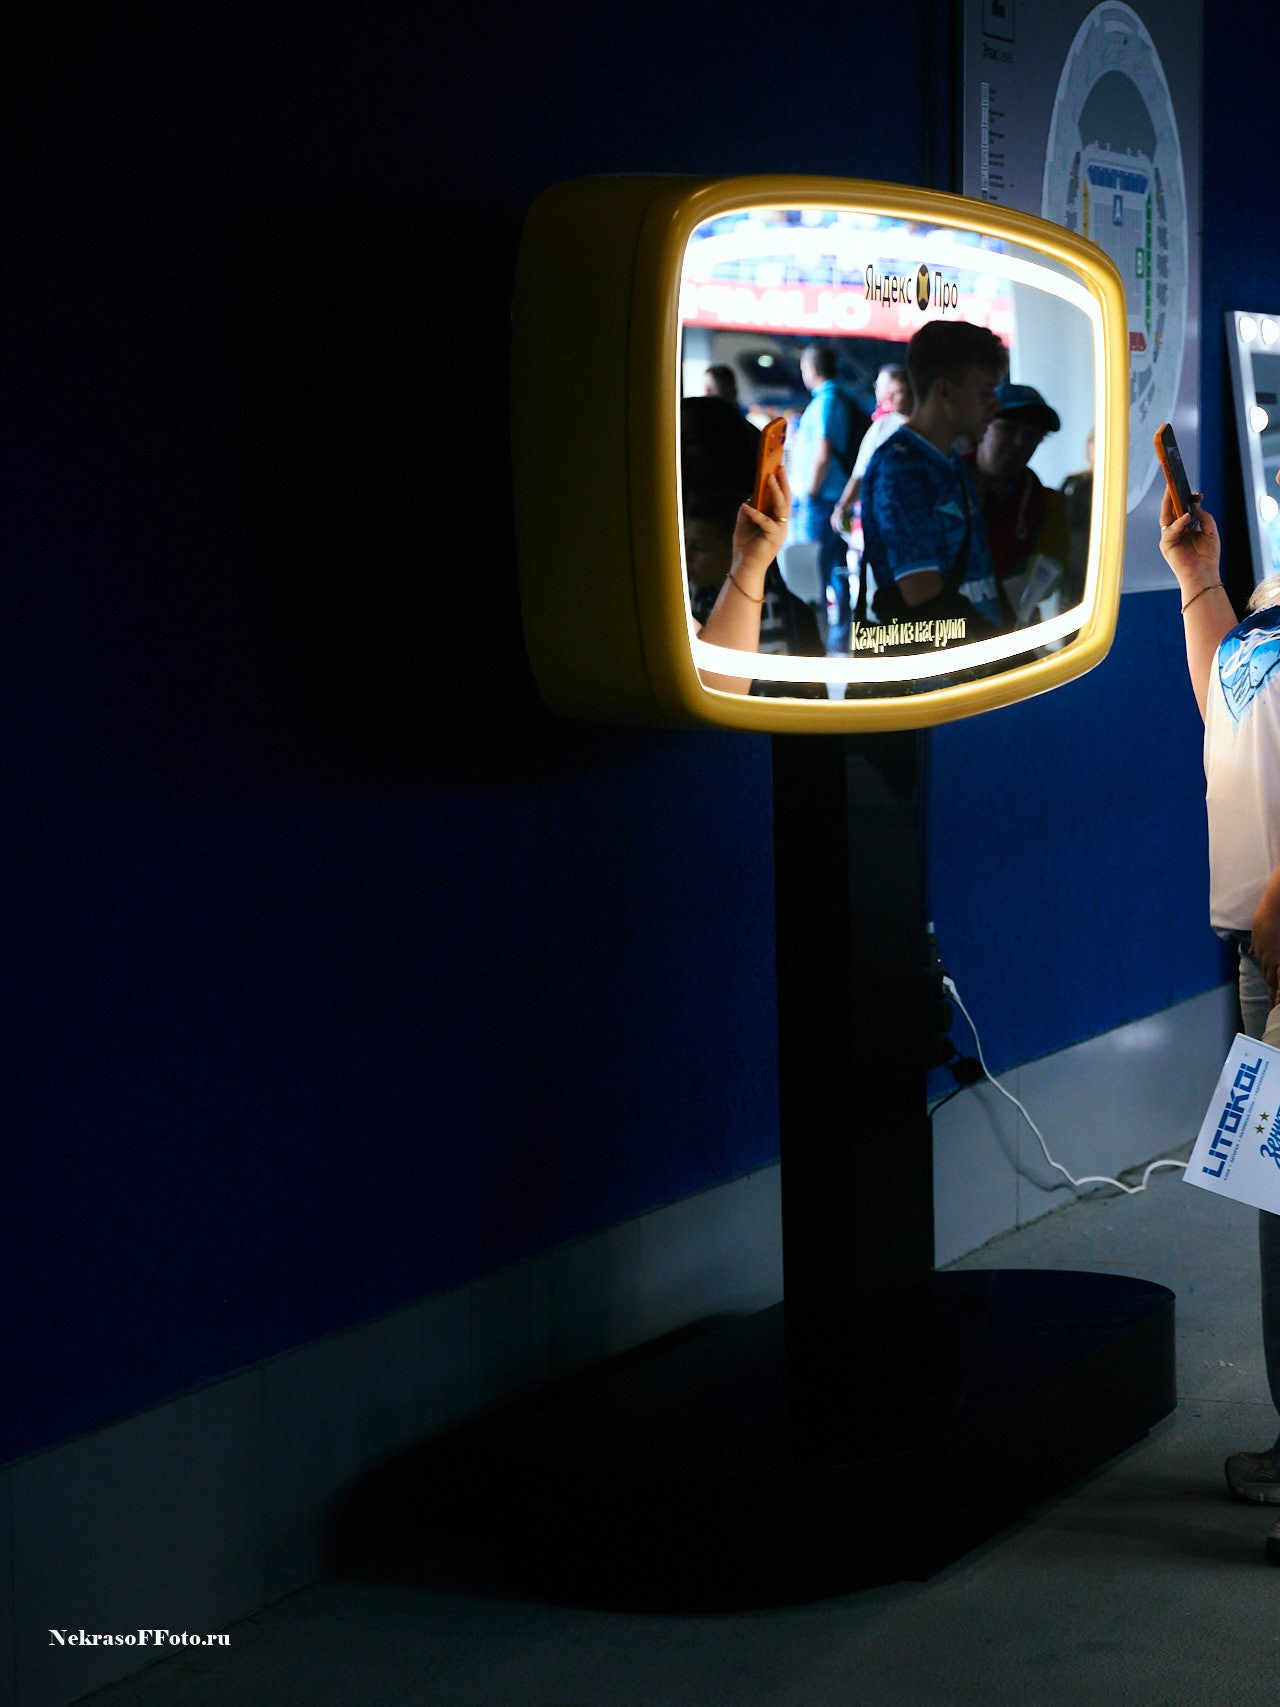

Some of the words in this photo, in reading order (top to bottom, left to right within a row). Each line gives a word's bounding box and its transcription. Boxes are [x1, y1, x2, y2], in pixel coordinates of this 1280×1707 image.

[865, 264, 912, 308] Яндекс
[933, 271, 958, 315] Про
[851, 618, 899, 654] Каждый
[900, 621, 914, 645] из
[915, 620, 934, 643] нас
[934, 618, 967, 648] рулит
[1202, 1058, 1263, 1178] LITOKOL
